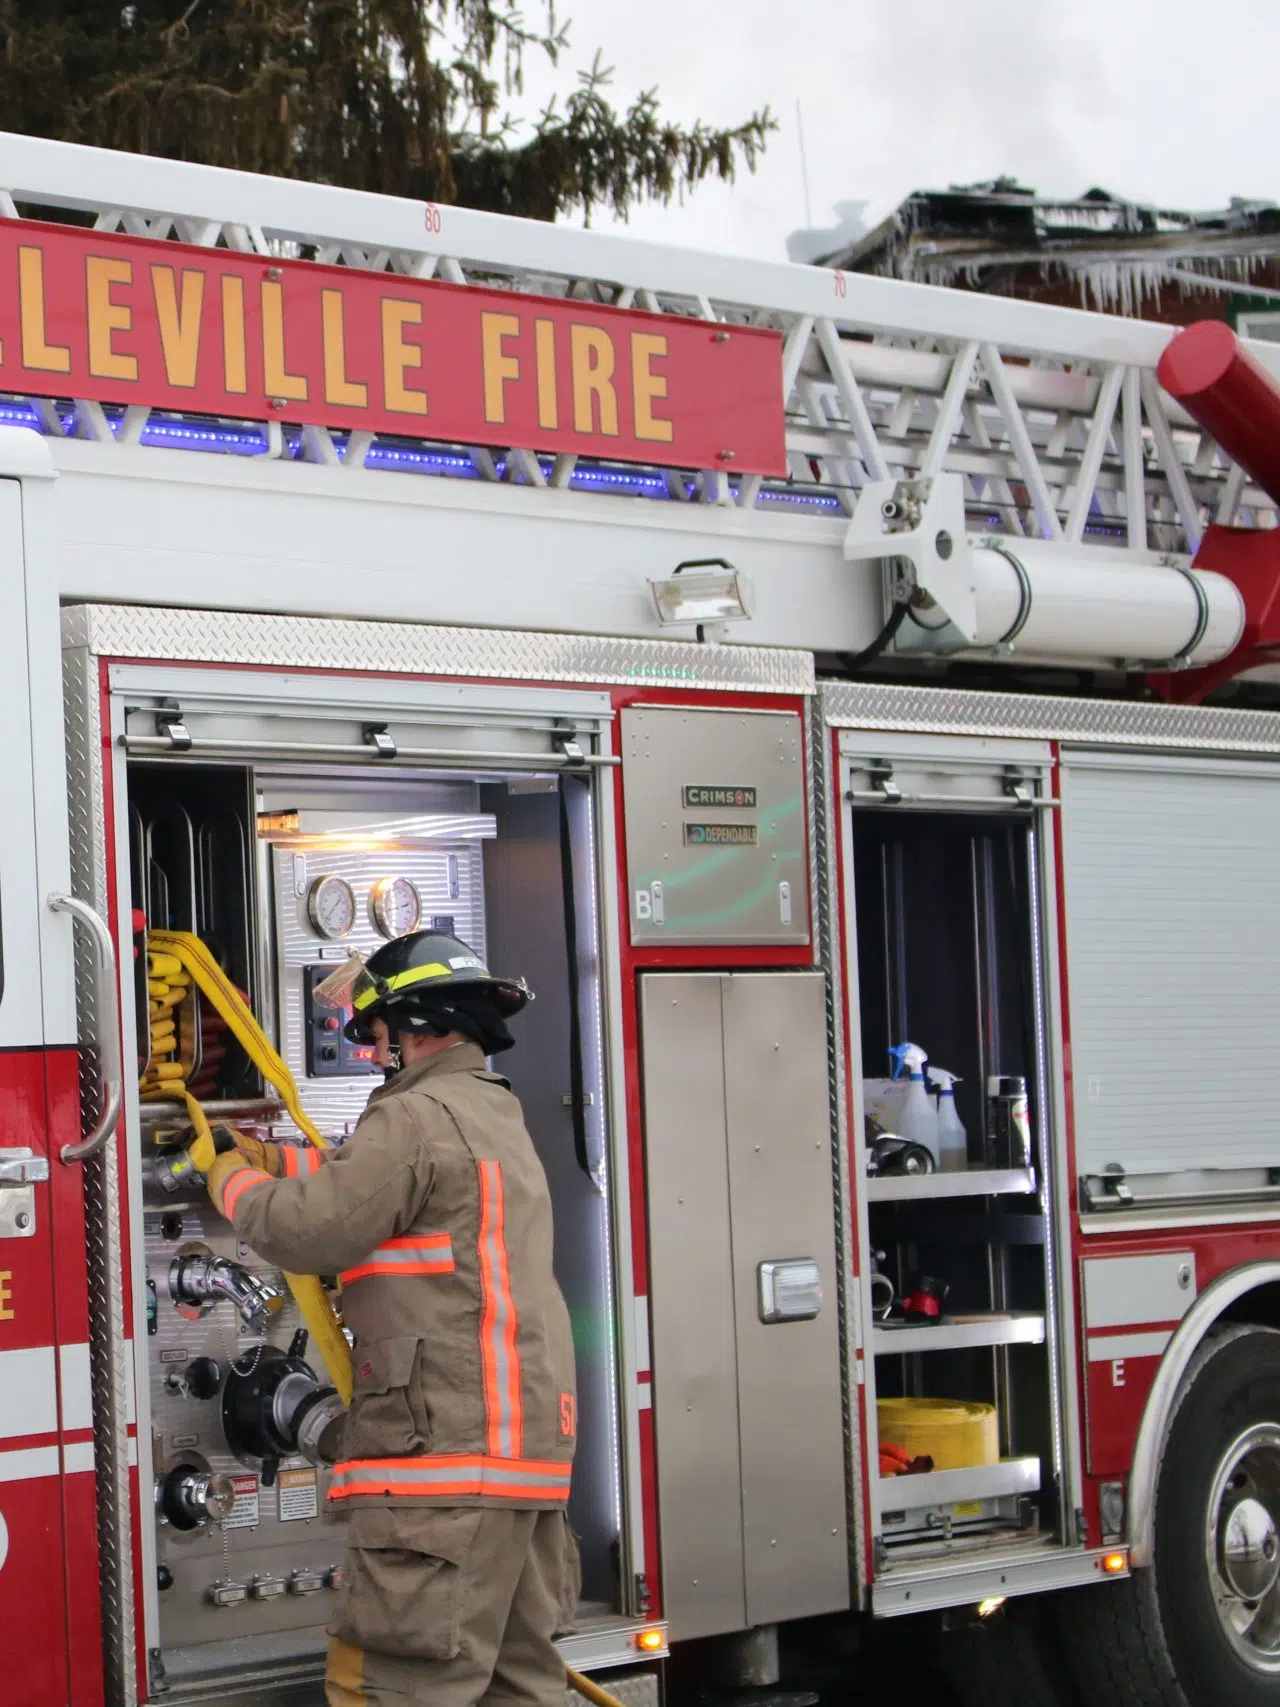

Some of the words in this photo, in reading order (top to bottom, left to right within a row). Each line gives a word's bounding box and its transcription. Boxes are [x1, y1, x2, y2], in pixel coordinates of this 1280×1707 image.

[424, 207, 441, 233] 80
[480, 310, 675, 444] FIRE
[688, 788, 754, 805] CRIMSON
[636, 890, 652, 919] B
[1112, 1359, 1126, 1387] E
